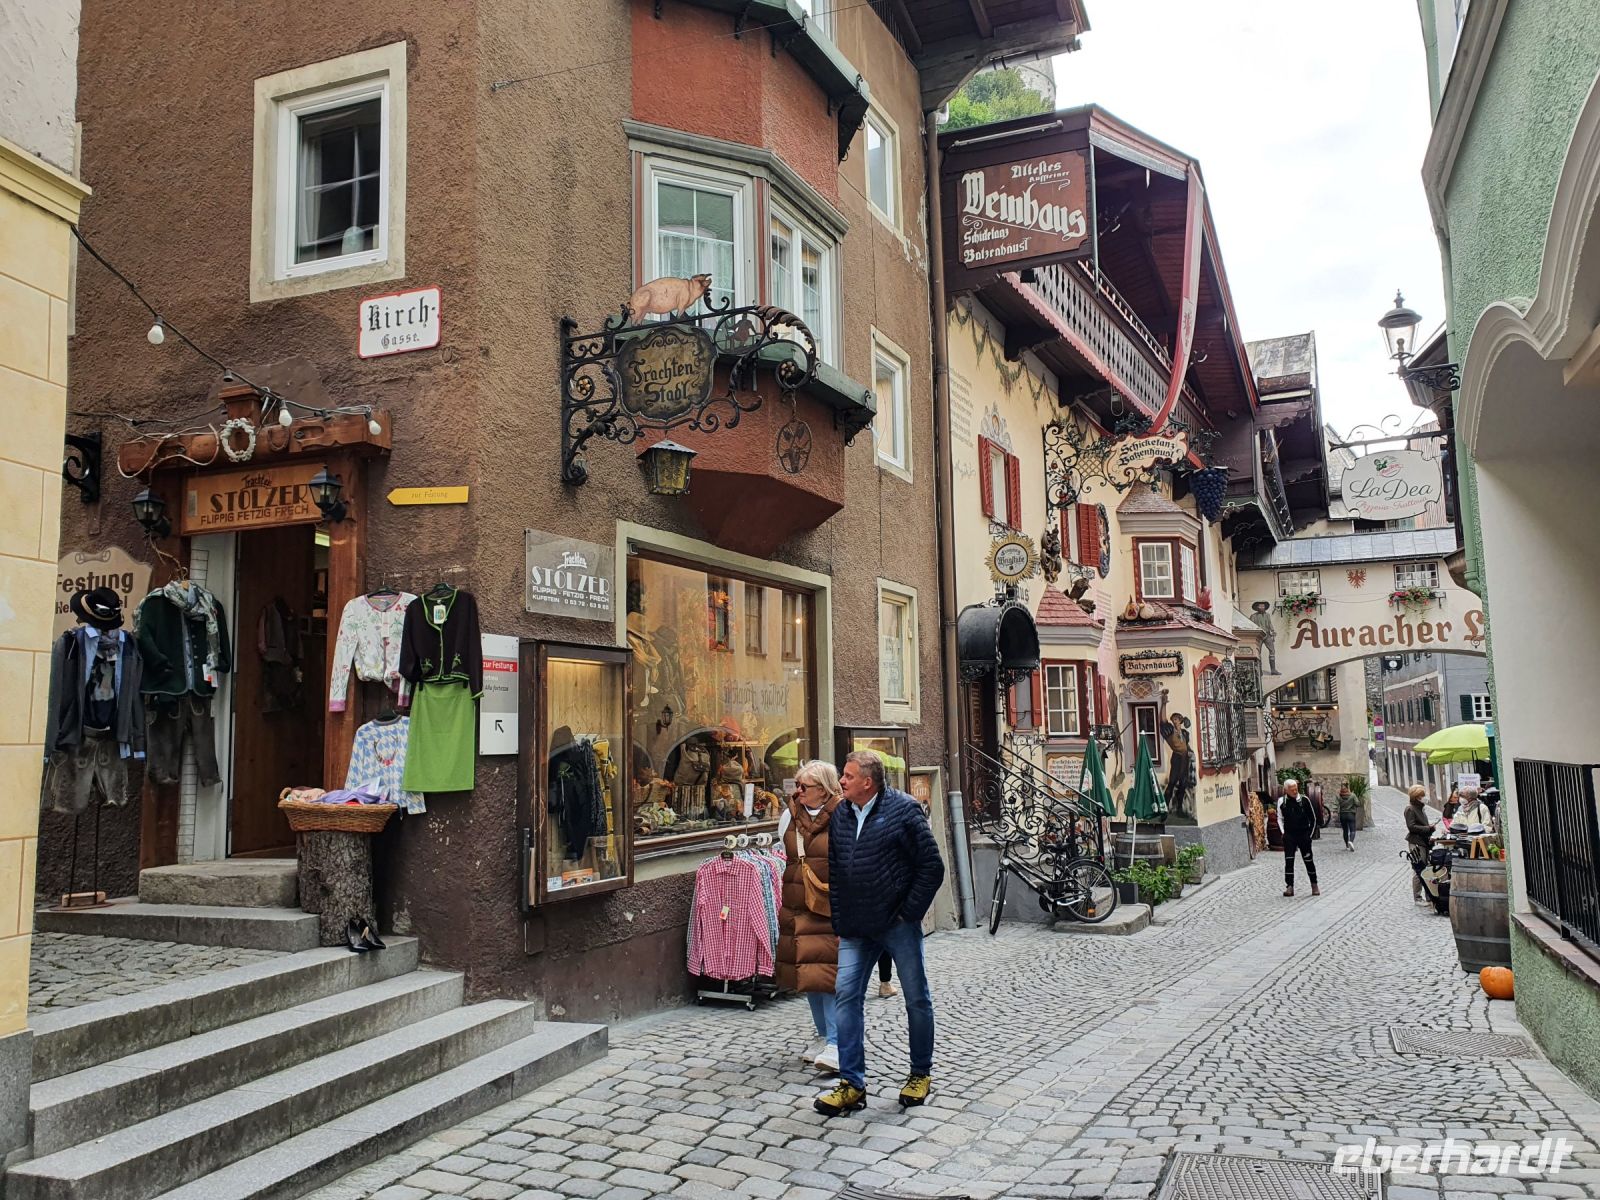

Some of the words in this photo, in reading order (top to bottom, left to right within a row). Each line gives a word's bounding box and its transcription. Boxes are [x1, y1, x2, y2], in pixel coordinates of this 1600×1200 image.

[961, 170, 1087, 242] Weinhaus
[628, 357, 695, 385] Trachten
[210, 483, 309, 513] STOLZER
[1349, 477, 1382, 500] La
[1382, 478, 1433, 501] Dea
[200, 512, 235, 525] FLIPPIG
[237, 508, 271, 521] FETZIG
[274, 504, 309, 517] FRECH
[557, 551, 588, 569] Trachten
[531, 565, 610, 596] STOLZER
[532, 585, 558, 595] FLIPPIG
[562, 590, 585, 600] FETZIG
[589, 594, 610, 602] FRECH
[532, 594, 561, 603] KUFSTEIN
[1290, 613, 1453, 650] Auracher
[492, 660, 514, 672] Festung
